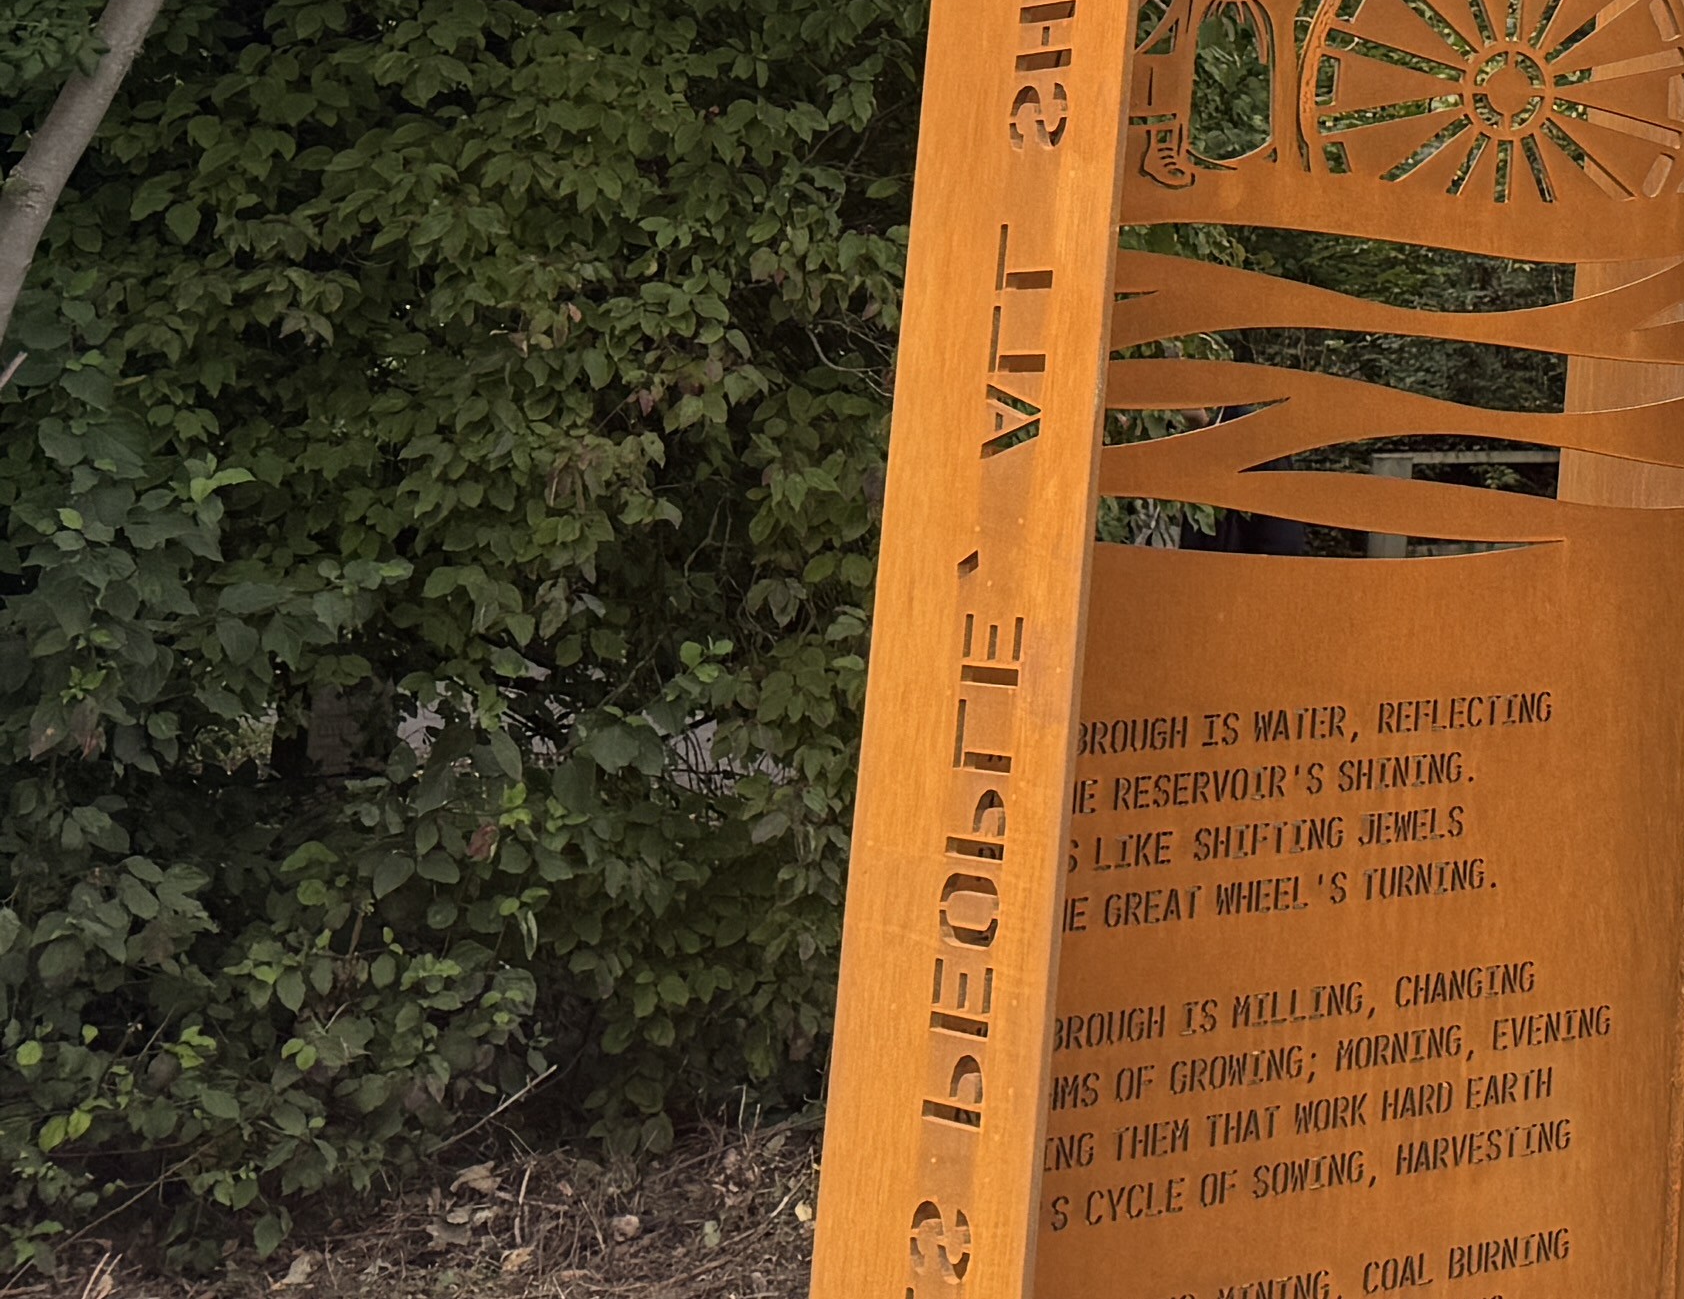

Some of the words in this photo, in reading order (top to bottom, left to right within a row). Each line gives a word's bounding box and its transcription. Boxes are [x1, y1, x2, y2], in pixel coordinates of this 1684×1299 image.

[1201, 712, 1240, 747] IS
[1254, 705, 1359, 744] WATER,
[1377, 691, 1552, 734] REFLECTING
[1113, 762, 1324, 811] RESERVOIR'S
[1338, 751, 1474, 792] SHINING.
[1092, 831, 1174, 871] LIKE
[1193, 816, 1344, 862] SHIFTING
[1357, 805, 1464, 846] JEWELS
[1103, 885, 1202, 928] GREAT
[1363, 858, 1496, 901] TURNING.
[1180, 998, 1219, 1036] IS
[1231, 981, 1375, 1029] MILLING,
[1395, 960, 1535, 1009] CHANGING
[1115, 1064, 1156, 1103] OF
[1169, 1045, 1317, 1096] GROWING;
[1335, 1024, 1474, 1072] MORNING,
[1492, 1004, 1611, 1051] EVENING
[1113, 1118, 1190, 1162] THEM
[1206, 1105, 1281, 1148] THAT
[1295, 1092, 1368, 1135] WORK
[1381, 1080, 1453, 1122] HARD
[1466, 1066, 1553, 1110] EARTH
[1084, 1177, 1186, 1226] CYCLE
[1200, 1169, 1238, 1208] OF
[1252, 1150, 1377, 1199] SOWING,
[1395, 1118, 1571, 1176] HARVESTING
[1362, 1252, 1433, 1295] COAL
[1448, 1227, 1570, 1280] BURNING
